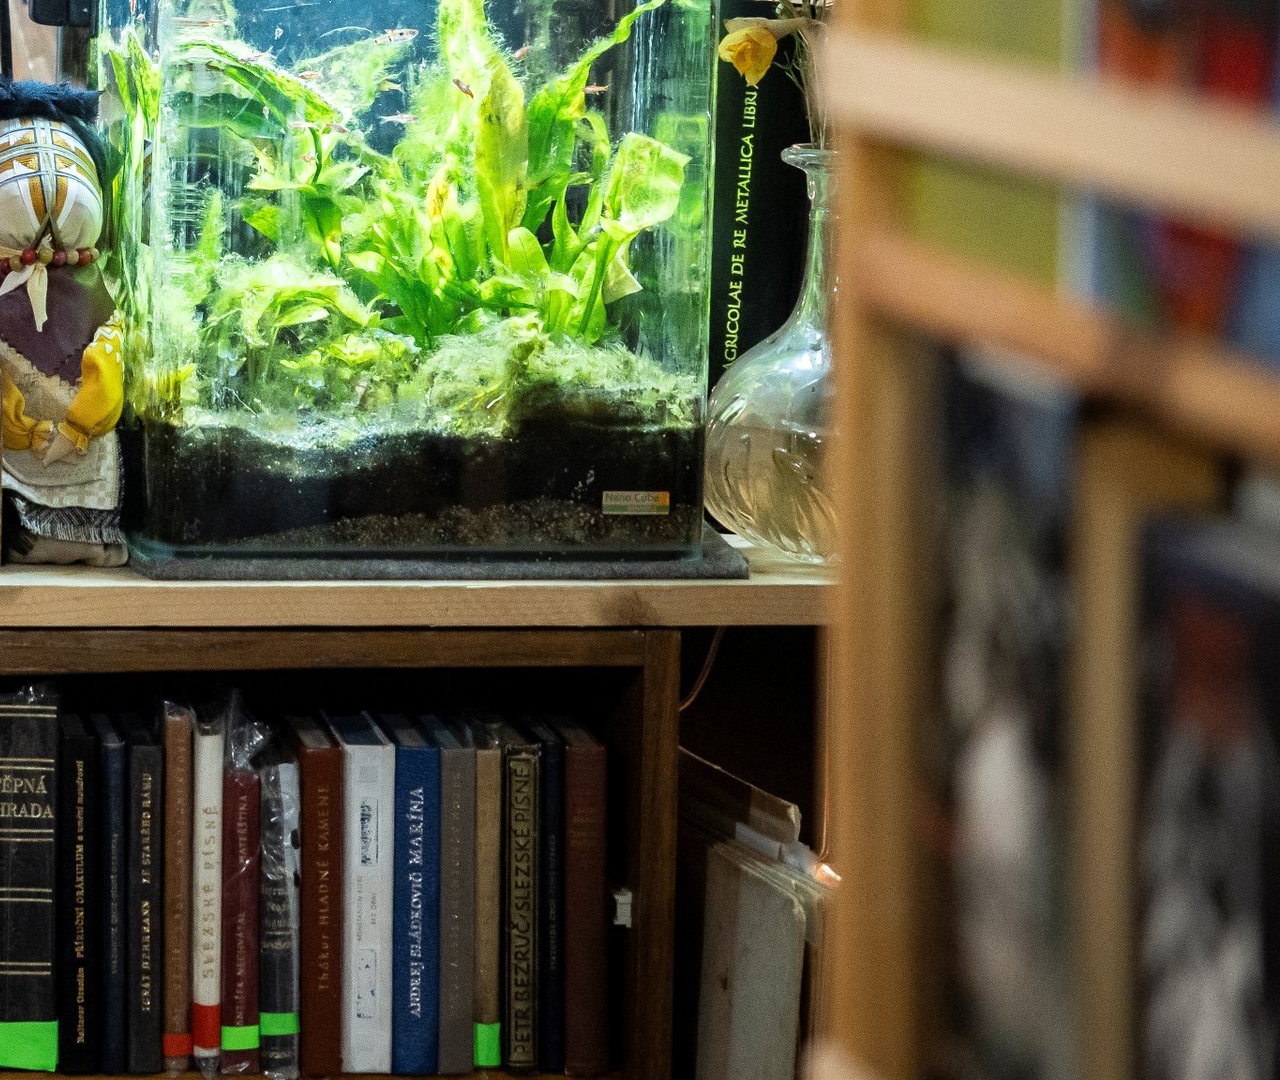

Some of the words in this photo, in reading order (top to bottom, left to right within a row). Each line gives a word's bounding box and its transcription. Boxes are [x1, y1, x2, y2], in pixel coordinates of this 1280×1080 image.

[735, 133, 755, 224] METALLICA
[731, 254, 745, 276] DE
[733, 229, 747, 248] RE
[405, 786, 424, 866] MARÍNA
[511, 765, 530, 823] PÍSNĚ
[201, 806, 218, 870] PÍSNĚ
[511, 827, 531, 910] SLEZSKÉ
[316, 860, 330, 925] HLADNÉ
[407, 872, 423, 958] SLÁDKOVIČ
[201, 885, 216, 979] SLEZSKÉ
[511, 914, 531, 1002] BEZRUČ
[408, 961, 424, 1018] ANDREJ
[513, 1008, 531, 1054] PETR
